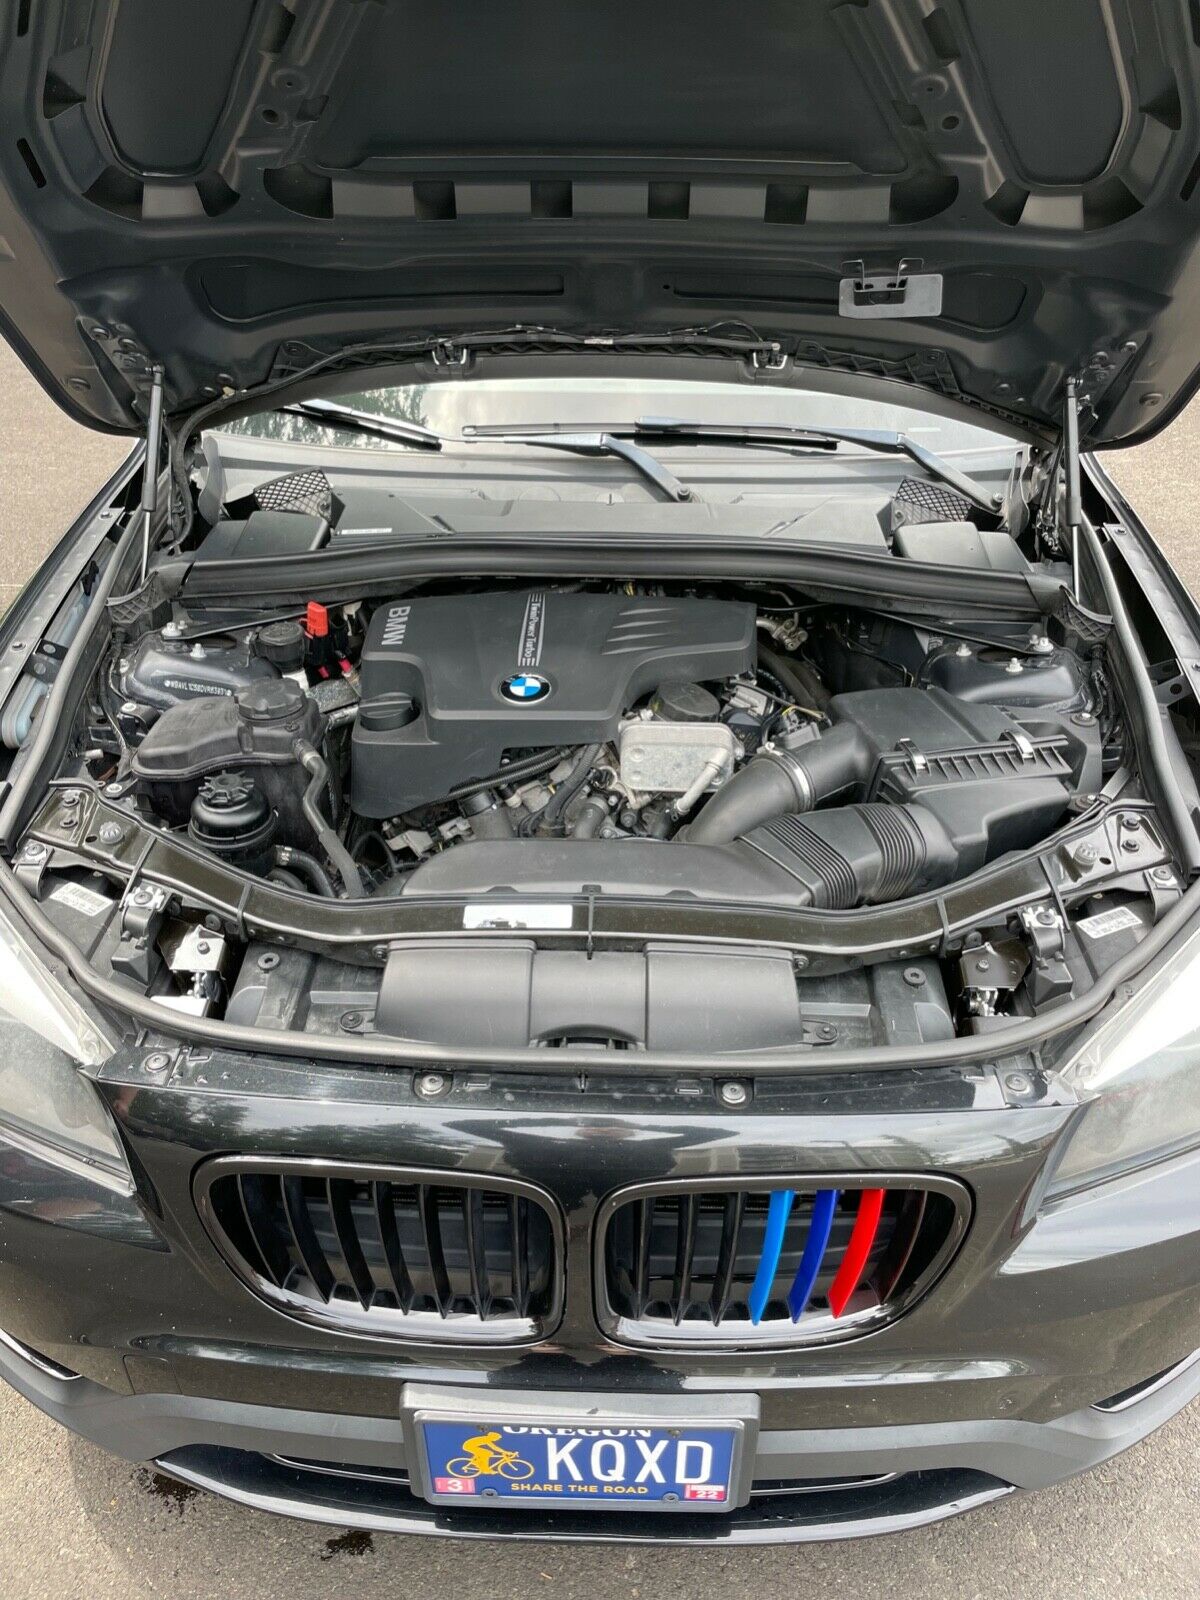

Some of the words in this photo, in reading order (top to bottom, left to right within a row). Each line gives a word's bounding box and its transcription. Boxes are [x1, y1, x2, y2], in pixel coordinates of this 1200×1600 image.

[381, 606, 411, 645] BMW
[526, 602, 541, 637] TwinPower
[523, 637, 537, 658] Turbo
[546, 1437, 713, 1485] KQXD
[447, 1478, 464, 1493] 3
[511, 1483, 563, 1492] SHARE
[567, 1484, 598, 1493] THE
[603, 1485, 649, 1494] ROAD
